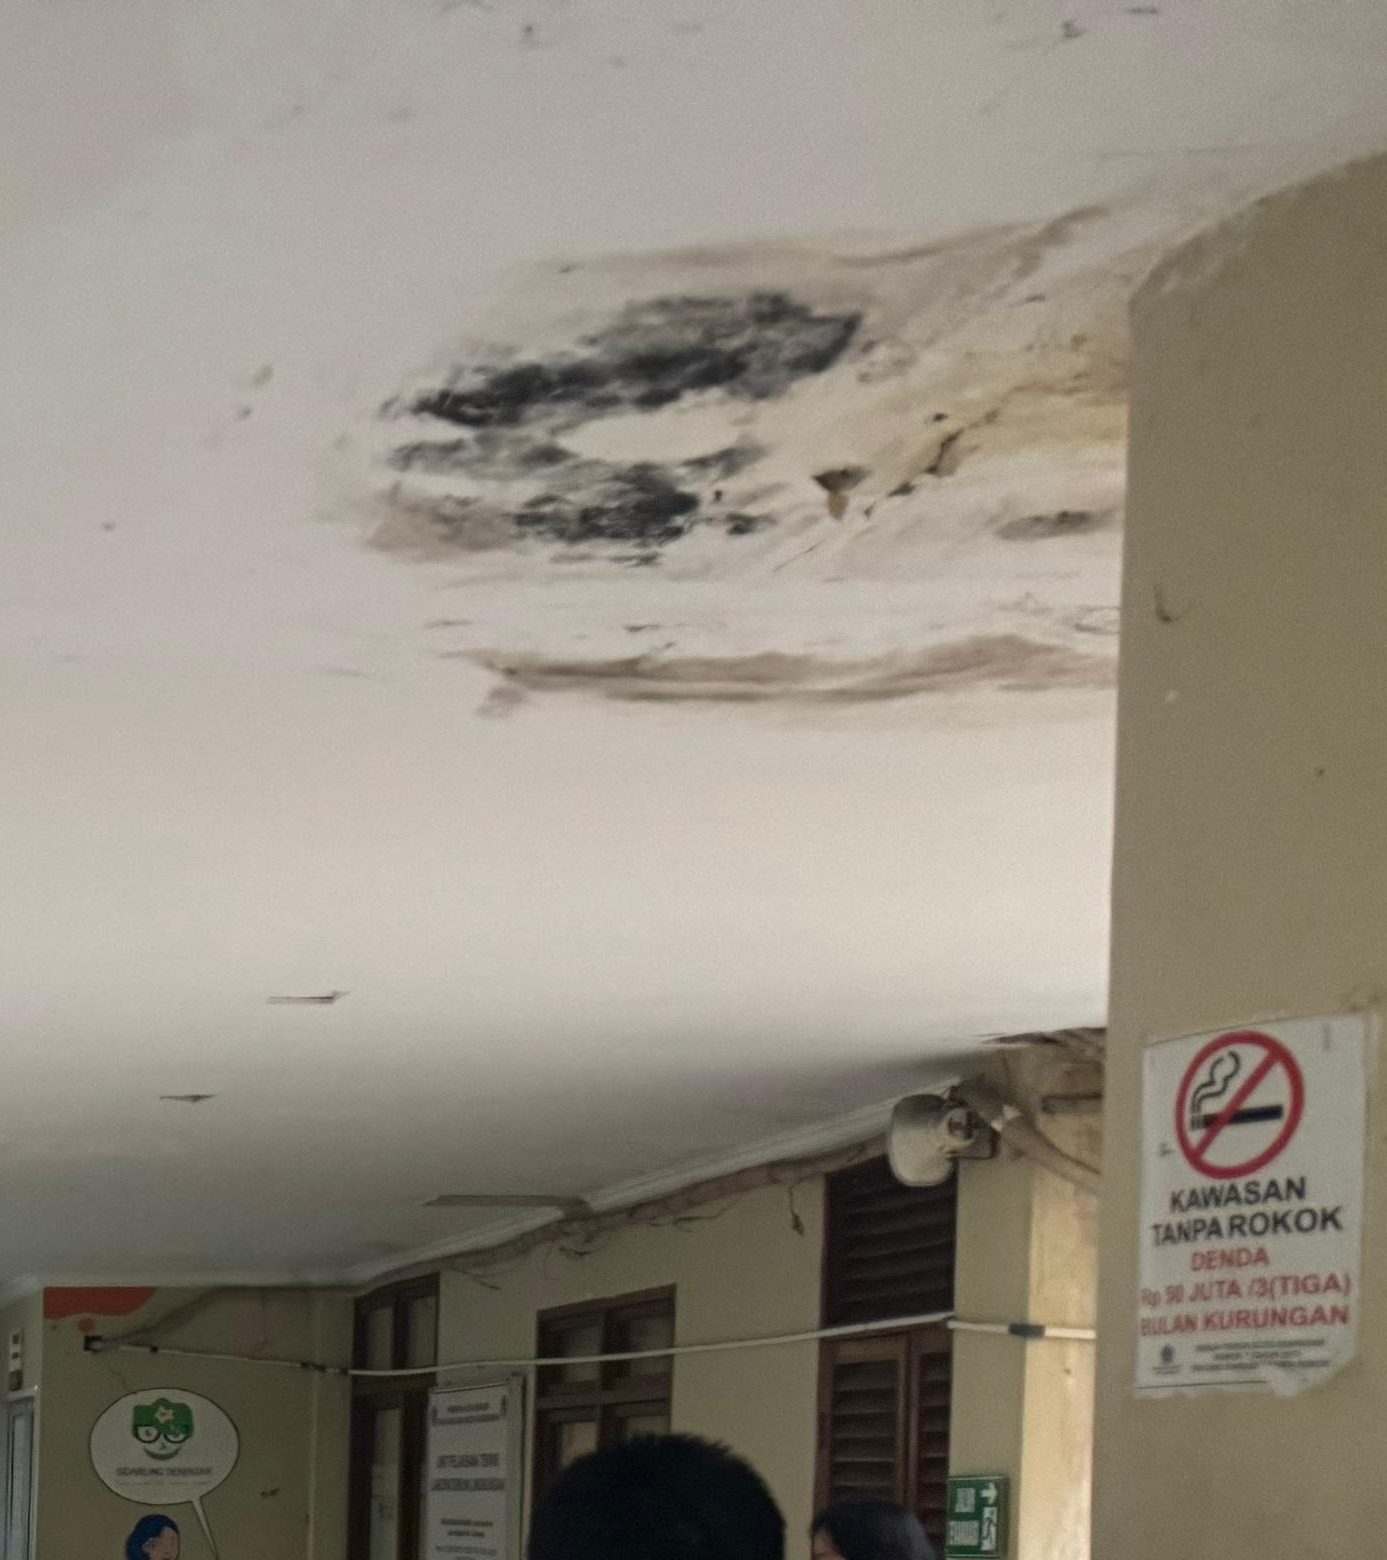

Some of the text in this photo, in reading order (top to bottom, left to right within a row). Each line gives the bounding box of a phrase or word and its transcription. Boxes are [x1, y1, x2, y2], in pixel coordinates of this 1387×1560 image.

[1170, 1177, 1305, 1213] KAWASAN
[1152, 1207, 1343, 1247] TANPA ROKOK
[1191, 1248, 1269, 1272] DENDA
[1189, 1280, 1241, 1301] JUTA
[1141, 1305, 1349, 1336] BULAN KURUNGAN
